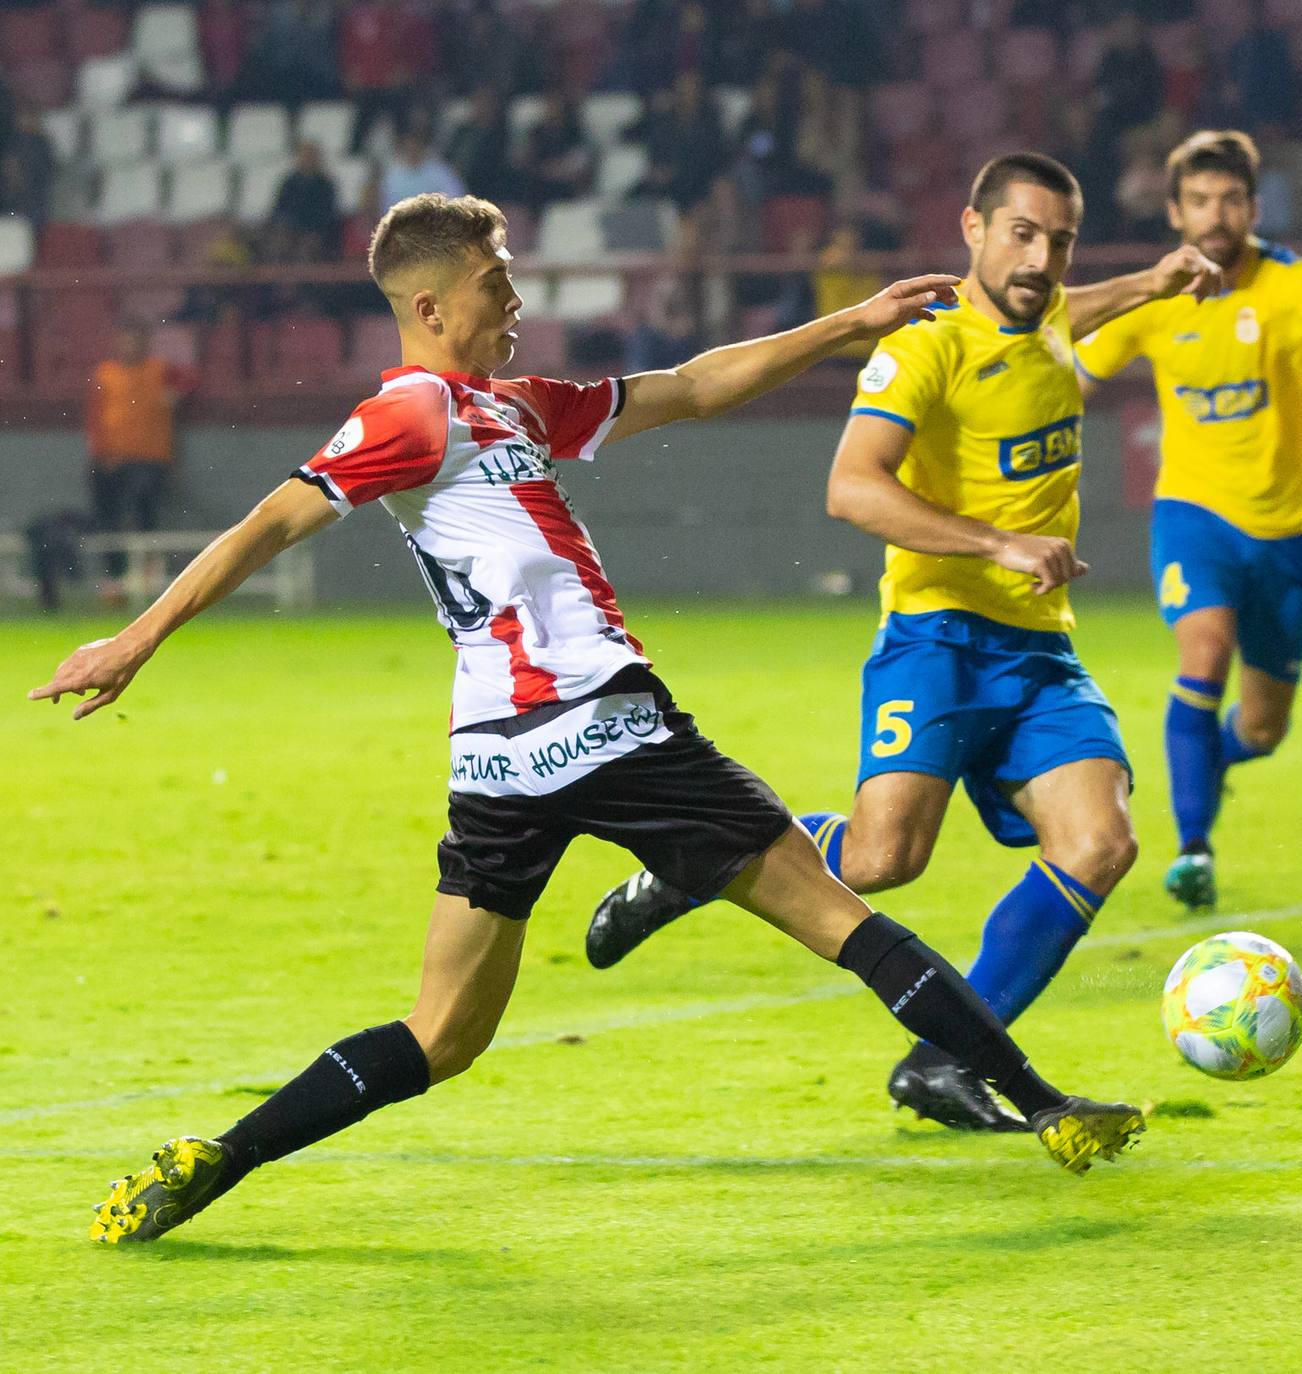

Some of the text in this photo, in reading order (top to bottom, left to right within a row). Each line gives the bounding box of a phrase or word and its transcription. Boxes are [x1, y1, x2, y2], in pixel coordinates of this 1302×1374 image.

[866, 366, 885, 388] 2B
[1161, 561, 1190, 608] 4
[529, 717, 624, 778] HOUSE
[871, 699, 914, 757] 5
[891, 967, 938, 1015] KELME
[325, 1048, 366, 1094] KELME
